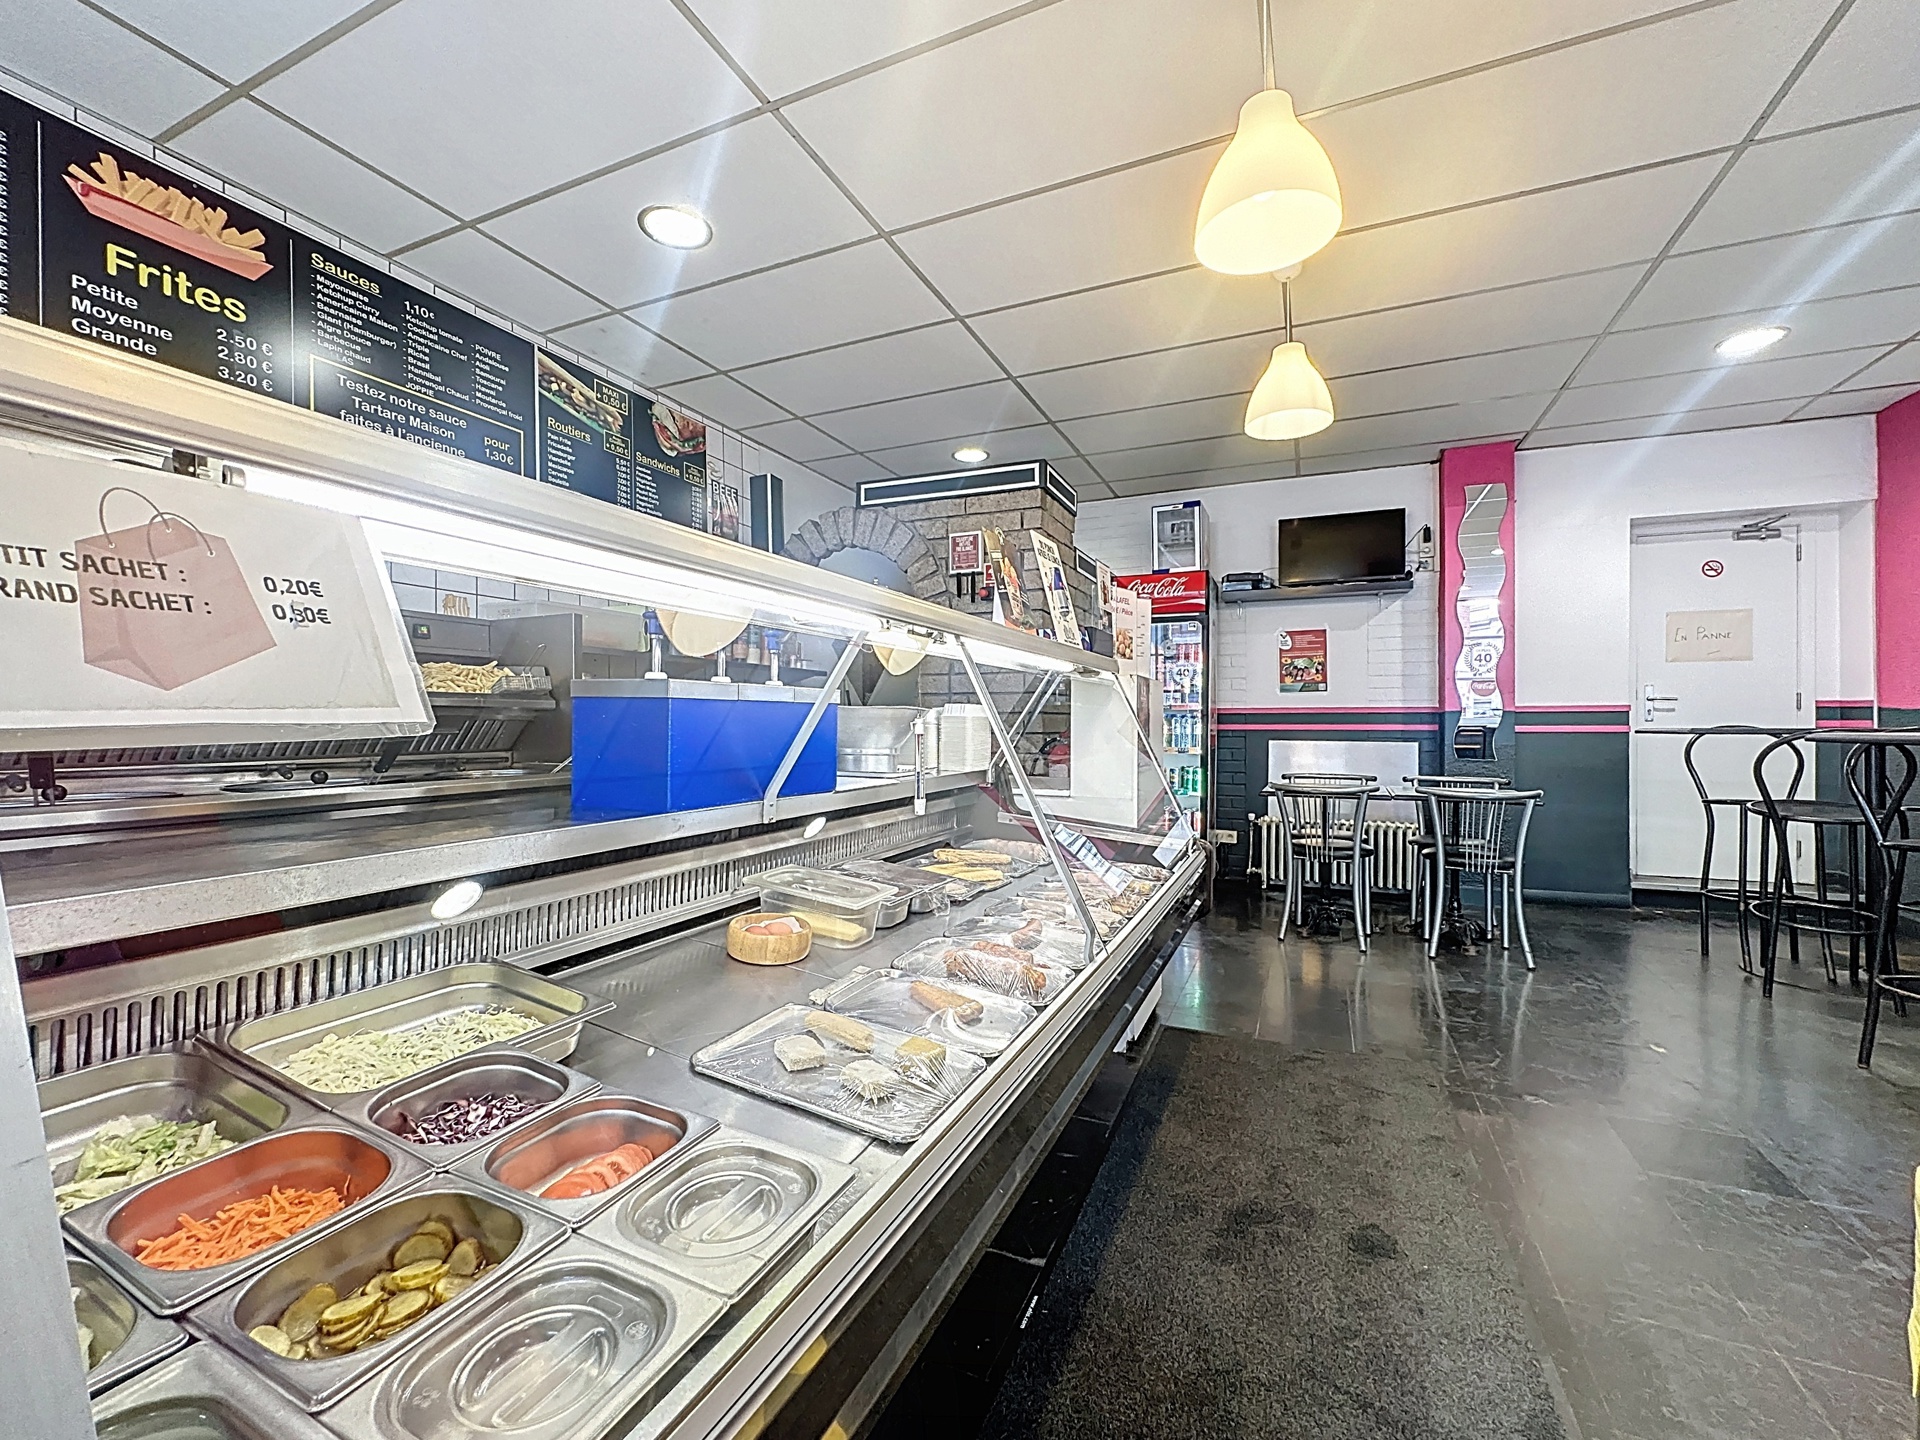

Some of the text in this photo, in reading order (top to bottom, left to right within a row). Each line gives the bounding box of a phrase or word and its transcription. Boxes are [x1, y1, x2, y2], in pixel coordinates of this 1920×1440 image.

[106, 242, 247, 323] Frites
[311, 252, 380, 294] Sauces
[71, 274, 138, 309] Petite
[316, 274, 370, 303] Mayonnaise
[316, 283, 380, 316] Ketchup Curry
[71, 295, 173, 341] Moyenne
[316, 310, 397, 350] Giant (Hamburger)
[369, 314, 399, 333] Maison
[405, 314, 464, 344] Ketchup tomate
[71, 318, 157, 356] Grande
[216, 328, 273, 356] 2.50 €
[316, 320, 372, 347] Aigre Douce
[317, 329, 361, 352] Barbecue
[407, 322, 439, 341] Cocktail
[317, 337, 372, 364] Lapin chaud
[407, 339, 430, 354] Triple
[407, 347, 430, 362] Riche
[450, 350, 468, 362] Chef
[217, 346, 273, 374] 2.80 €
[407, 355, 430, 370] Brasil
[407, 363, 442, 382] Hannibal
[475, 352, 510, 372] Andalouse
[217, 366, 273, 392] 3.20 €
[405, 381, 435, 398] JOPPIE
[475, 375, 503, 392] Toscane
[336, 373, 467, 429] Testez notre sauce
[446, 387, 470, 401] Chaud
[475, 391, 507, 408] Moutarde
[602, 386, 619, 399] MAXI
[340, 409, 382, 432] faites
[385, 424, 396, 437] à
[351, 396, 456, 441] Tartare Maison
[508, 411, 523, 421] froid
[547, 416, 591, 442] Routiers
[484, 436, 511, 452] pour
[484, 448, 515, 466] 1,30€
[636, 451, 680, 476] Sandwichs
[712, 481, 737, 499] BEEF
[60, 551, 168, 581] SACHET
[263, 576, 324, 598] 0,20€
[89, 586, 195, 614] SACHET
[1474, 653, 1492, 663] 40
